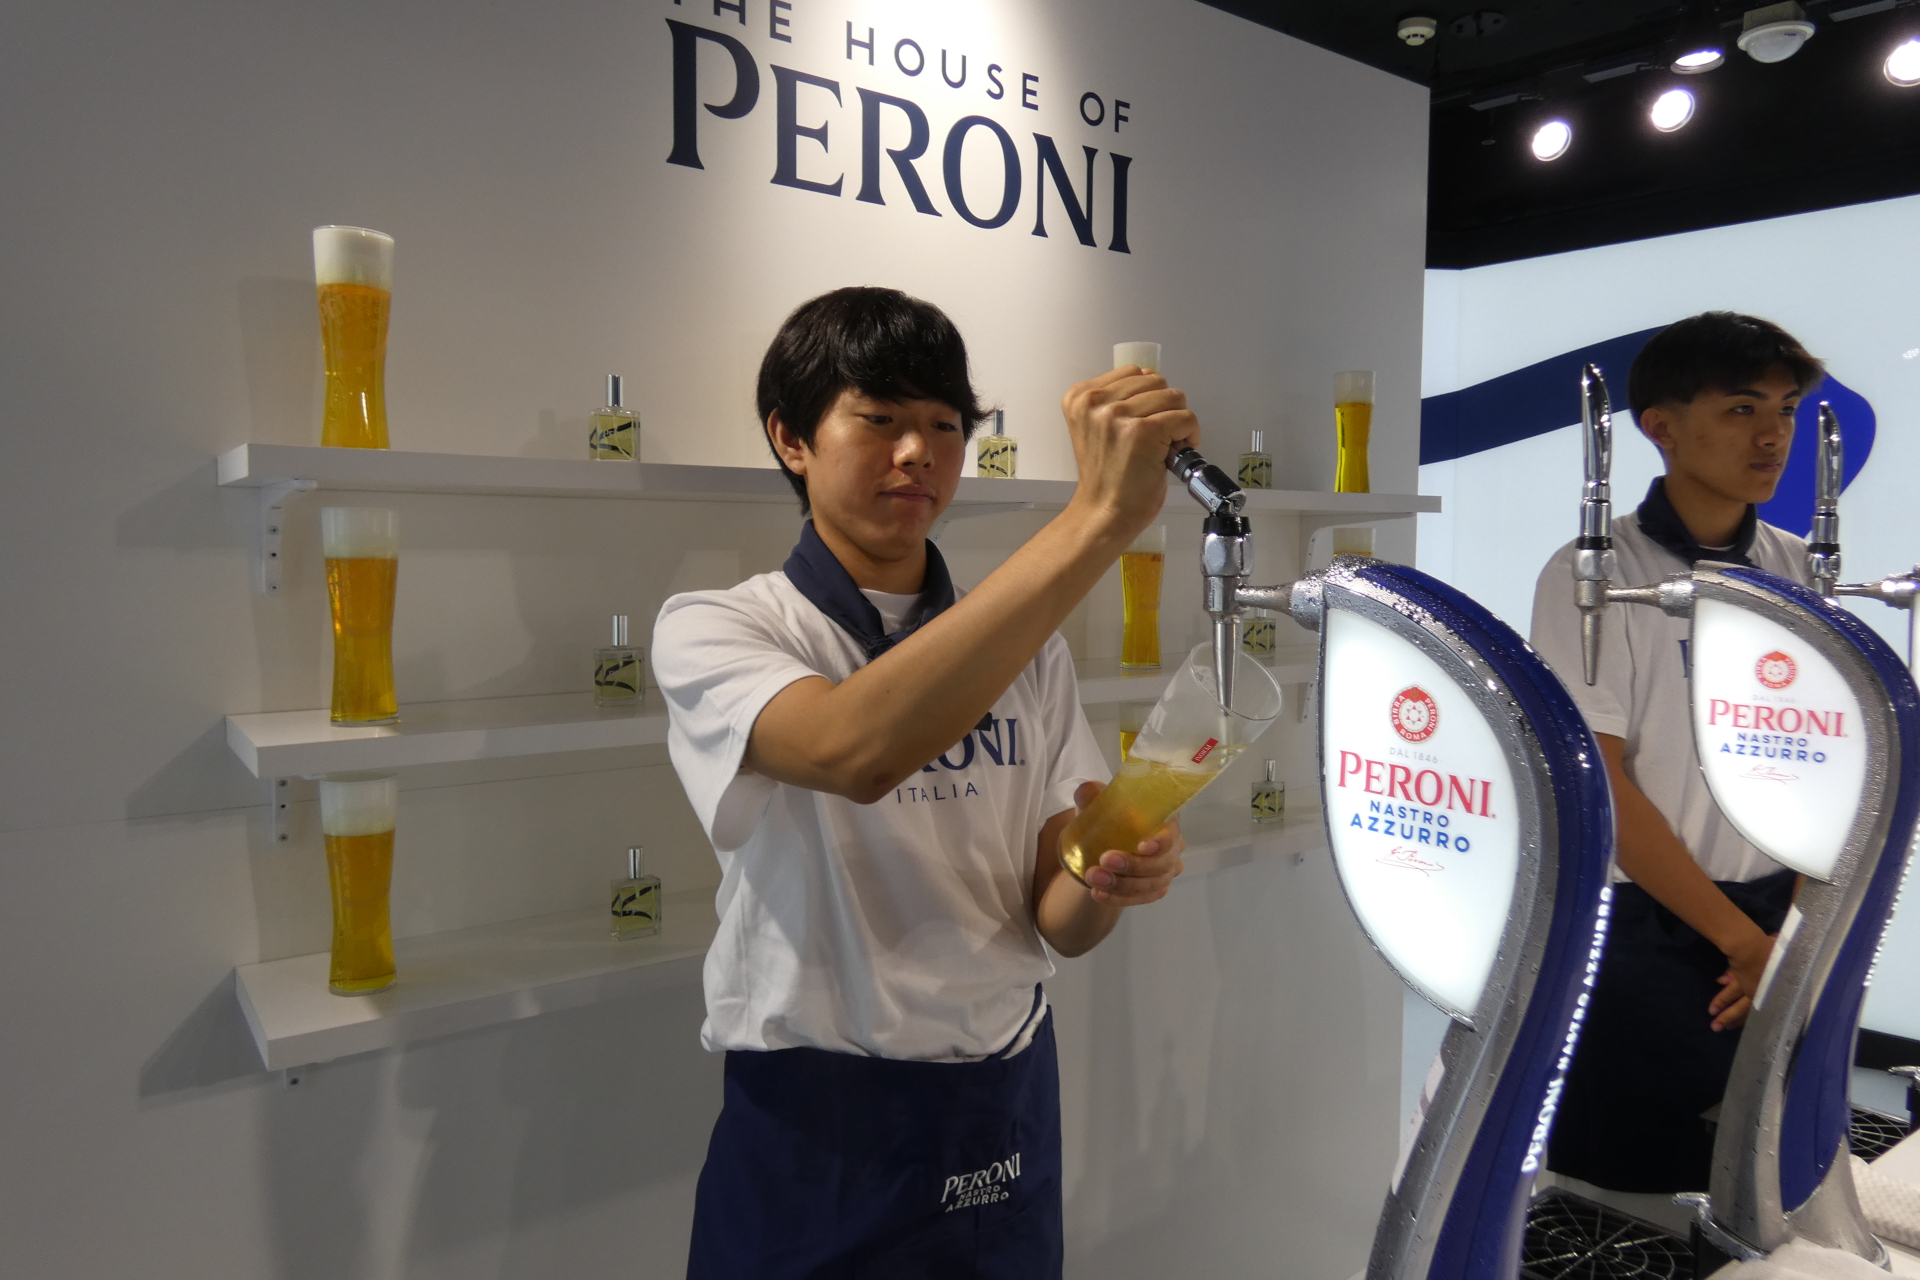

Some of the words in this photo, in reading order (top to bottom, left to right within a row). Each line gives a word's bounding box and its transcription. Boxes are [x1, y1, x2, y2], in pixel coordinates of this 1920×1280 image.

[674, 0, 792, 44] HE
[846, 20, 1040, 112] HOUSE
[1080, 91, 1131, 134] OF
[665, 17, 1133, 255] PERONI
[1391, 694, 1406, 726] BIRRA
[1424, 697, 1437, 732] PERONI
[1708, 698, 1846, 738] PERONI
[922, 718, 1018, 773] ONI
[1399, 728, 1428, 740] ROMA
[1737, 732, 1808, 747] NASTRO
[1389, 746, 1409, 759] DAL
[1413, 750, 1439, 764] 1846
[1720, 743, 1827, 763] AZZURRO
[897, 781, 979, 804] ITALIA
[1337, 750, 1492, 818] PERONI
[1370, 799, 1450, 828] NASTRO
[1350, 812, 1471, 853] AZZURRO
[940, 1152, 1021, 1204] PERONI
[959, 1184, 1001, 1201] NASTRO
[945, 1191, 1010, 1213] AZZURRO
